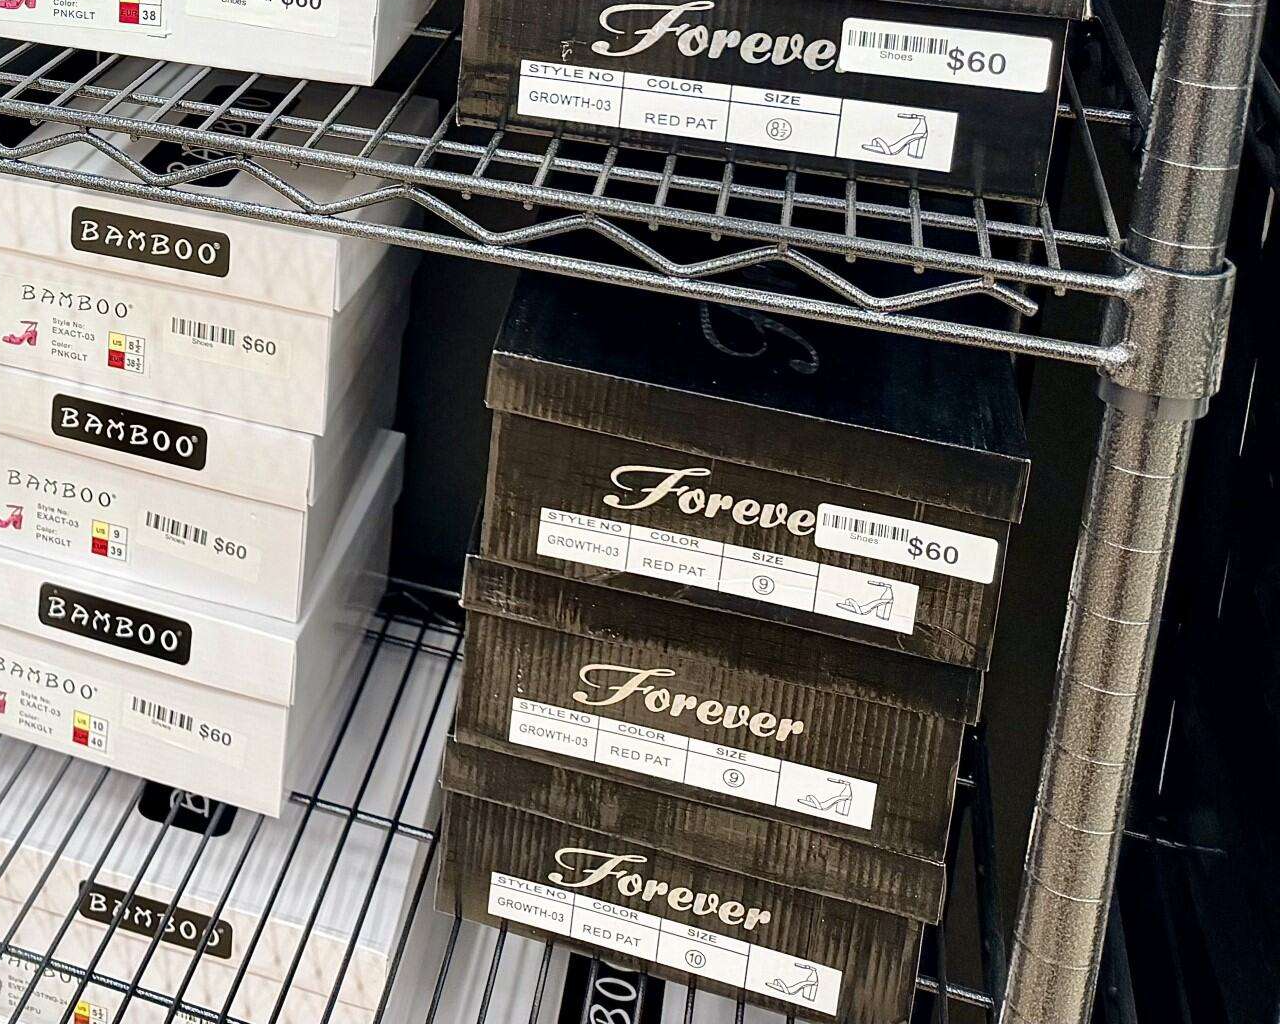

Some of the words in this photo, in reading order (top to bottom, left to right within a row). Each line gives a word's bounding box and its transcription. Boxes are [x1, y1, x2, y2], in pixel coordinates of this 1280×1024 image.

[53, 9, 95, 19] PNKGLT
[142, 9, 156, 21] 38
[591, 1, 845, 73] Foreve
[879, 50, 913, 62] Shoes
[946, 47, 1007, 75] $60
[529, 64, 583, 79] STYLE
[587, 71, 614, 82] NO
[646, 79, 703, 93] COLOR
[529, 90, 612, 111] GROWTH-03
[764, 93, 800, 105] SIZE
[645, 112, 683, 126] RED
[686, 116, 718, 131] PAT
[52, 327, 95, 342] EXACT-03
[51, 348, 87, 361] PNKGLT
[242, 336, 276, 355] $60
[603, 466, 816, 536] Foreve
[37, 512, 79, 528] EXACT-03
[549, 511, 594, 529] STYLE
[599, 521, 622, 533] NO
[213, 538, 247, 559] $60
[548, 534, 620, 559] GROWTH-03
[651, 531, 700, 548] COLOR
[850, 533, 878, 545] Shoes
[752, 552, 784, 566] SIZE
[908, 537, 959, 565] $60
[643, 558, 674, 573] RED
[678, 564, 707, 578] PAT
[573, 663, 804, 742] Forever
[520, 702, 564, 719] STYLE
[568, 712, 591, 724] NO
[199, 724, 232, 746] $60
[519, 724, 588, 747] GROWTH-03
[618, 724, 666, 741] COLOR
[610, 745, 640, 760] RED
[644, 752, 672, 767] PAT
[717, 747, 747, 761] SIZE
[548, 847, 771, 931] Forever
[497, 898, 565, 923] GROWTH-03
[593, 901, 639, 920] COLOR
[582, 924, 611, 940] RED
[614, 932, 641, 947] PAT
[688, 928, 718, 943] SIZE
